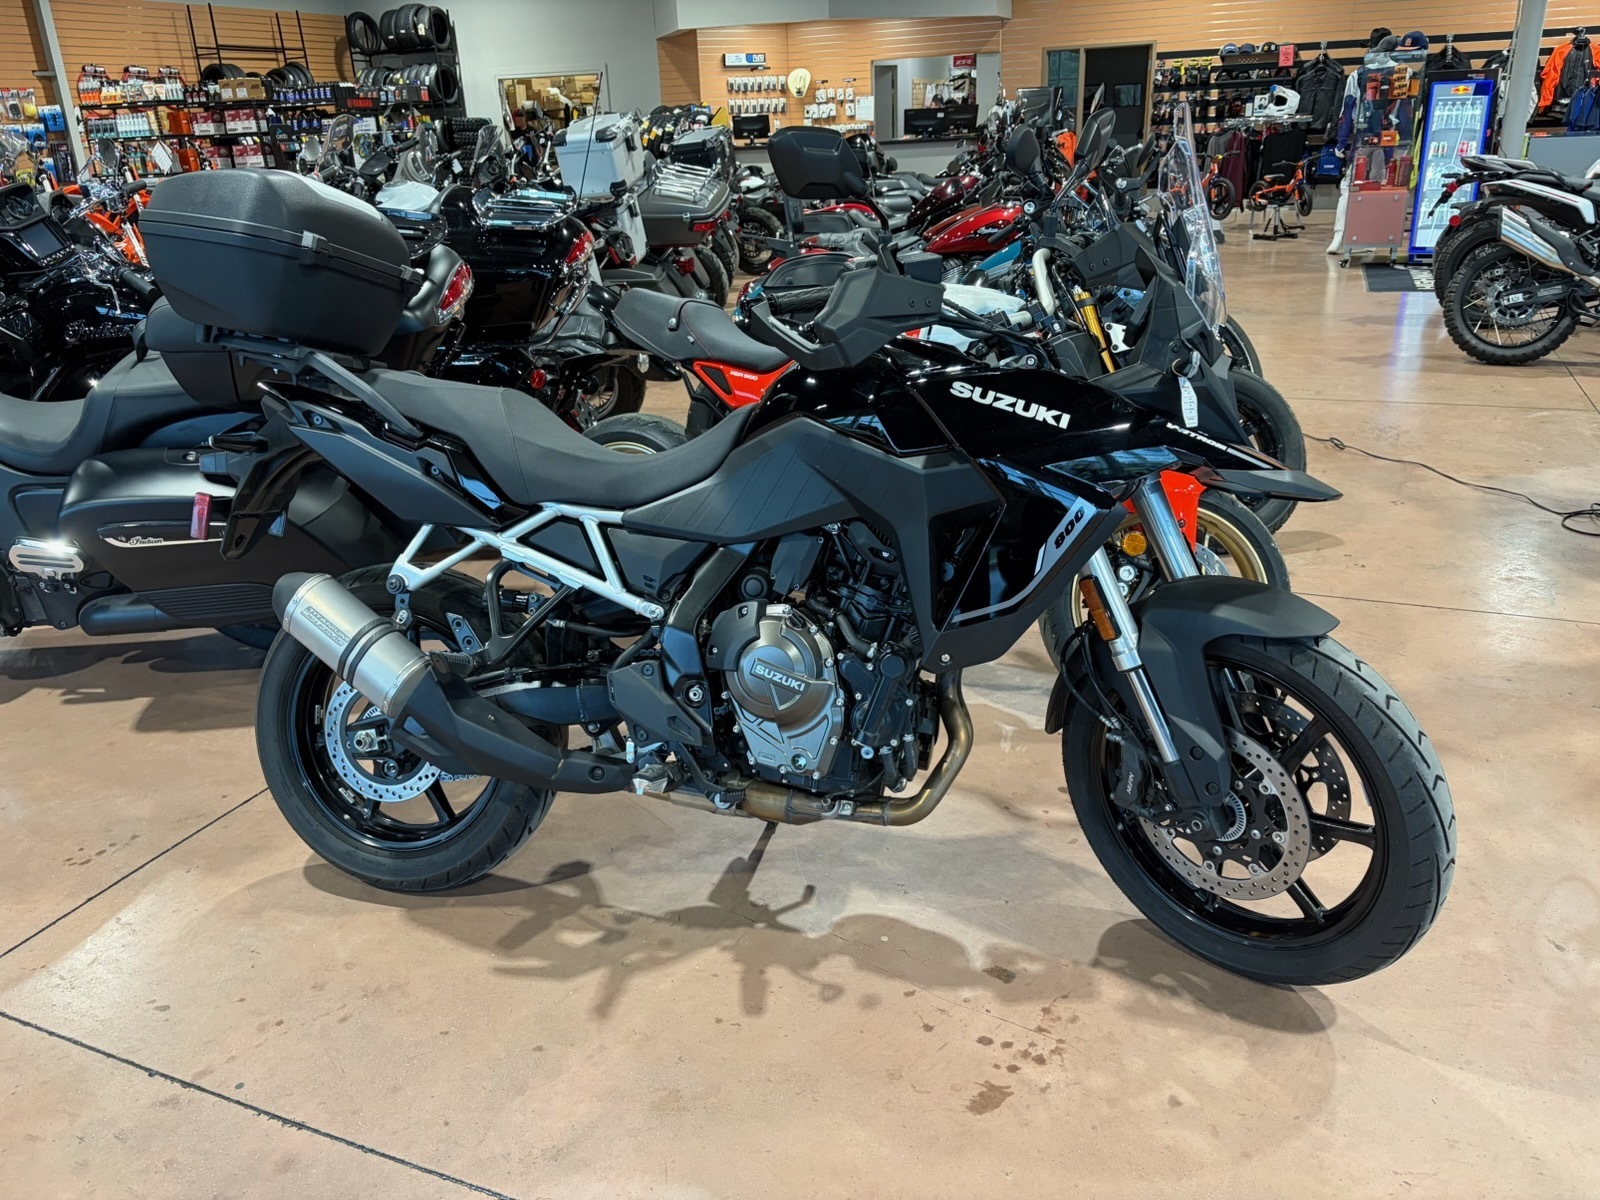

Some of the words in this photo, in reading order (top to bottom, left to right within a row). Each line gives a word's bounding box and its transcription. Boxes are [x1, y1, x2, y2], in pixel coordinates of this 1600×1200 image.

[353, 99, 373, 107] YAMAHA
[950, 381, 1071, 429] SUZUKI
[1166, 422, 1227, 451] V-STROM
[129, 536, 164, 546] Indian
[1054, 506, 1085, 549] 800
[305, 605, 350, 643] TITANIUM
[755, 664, 806, 691] SUZUKI
